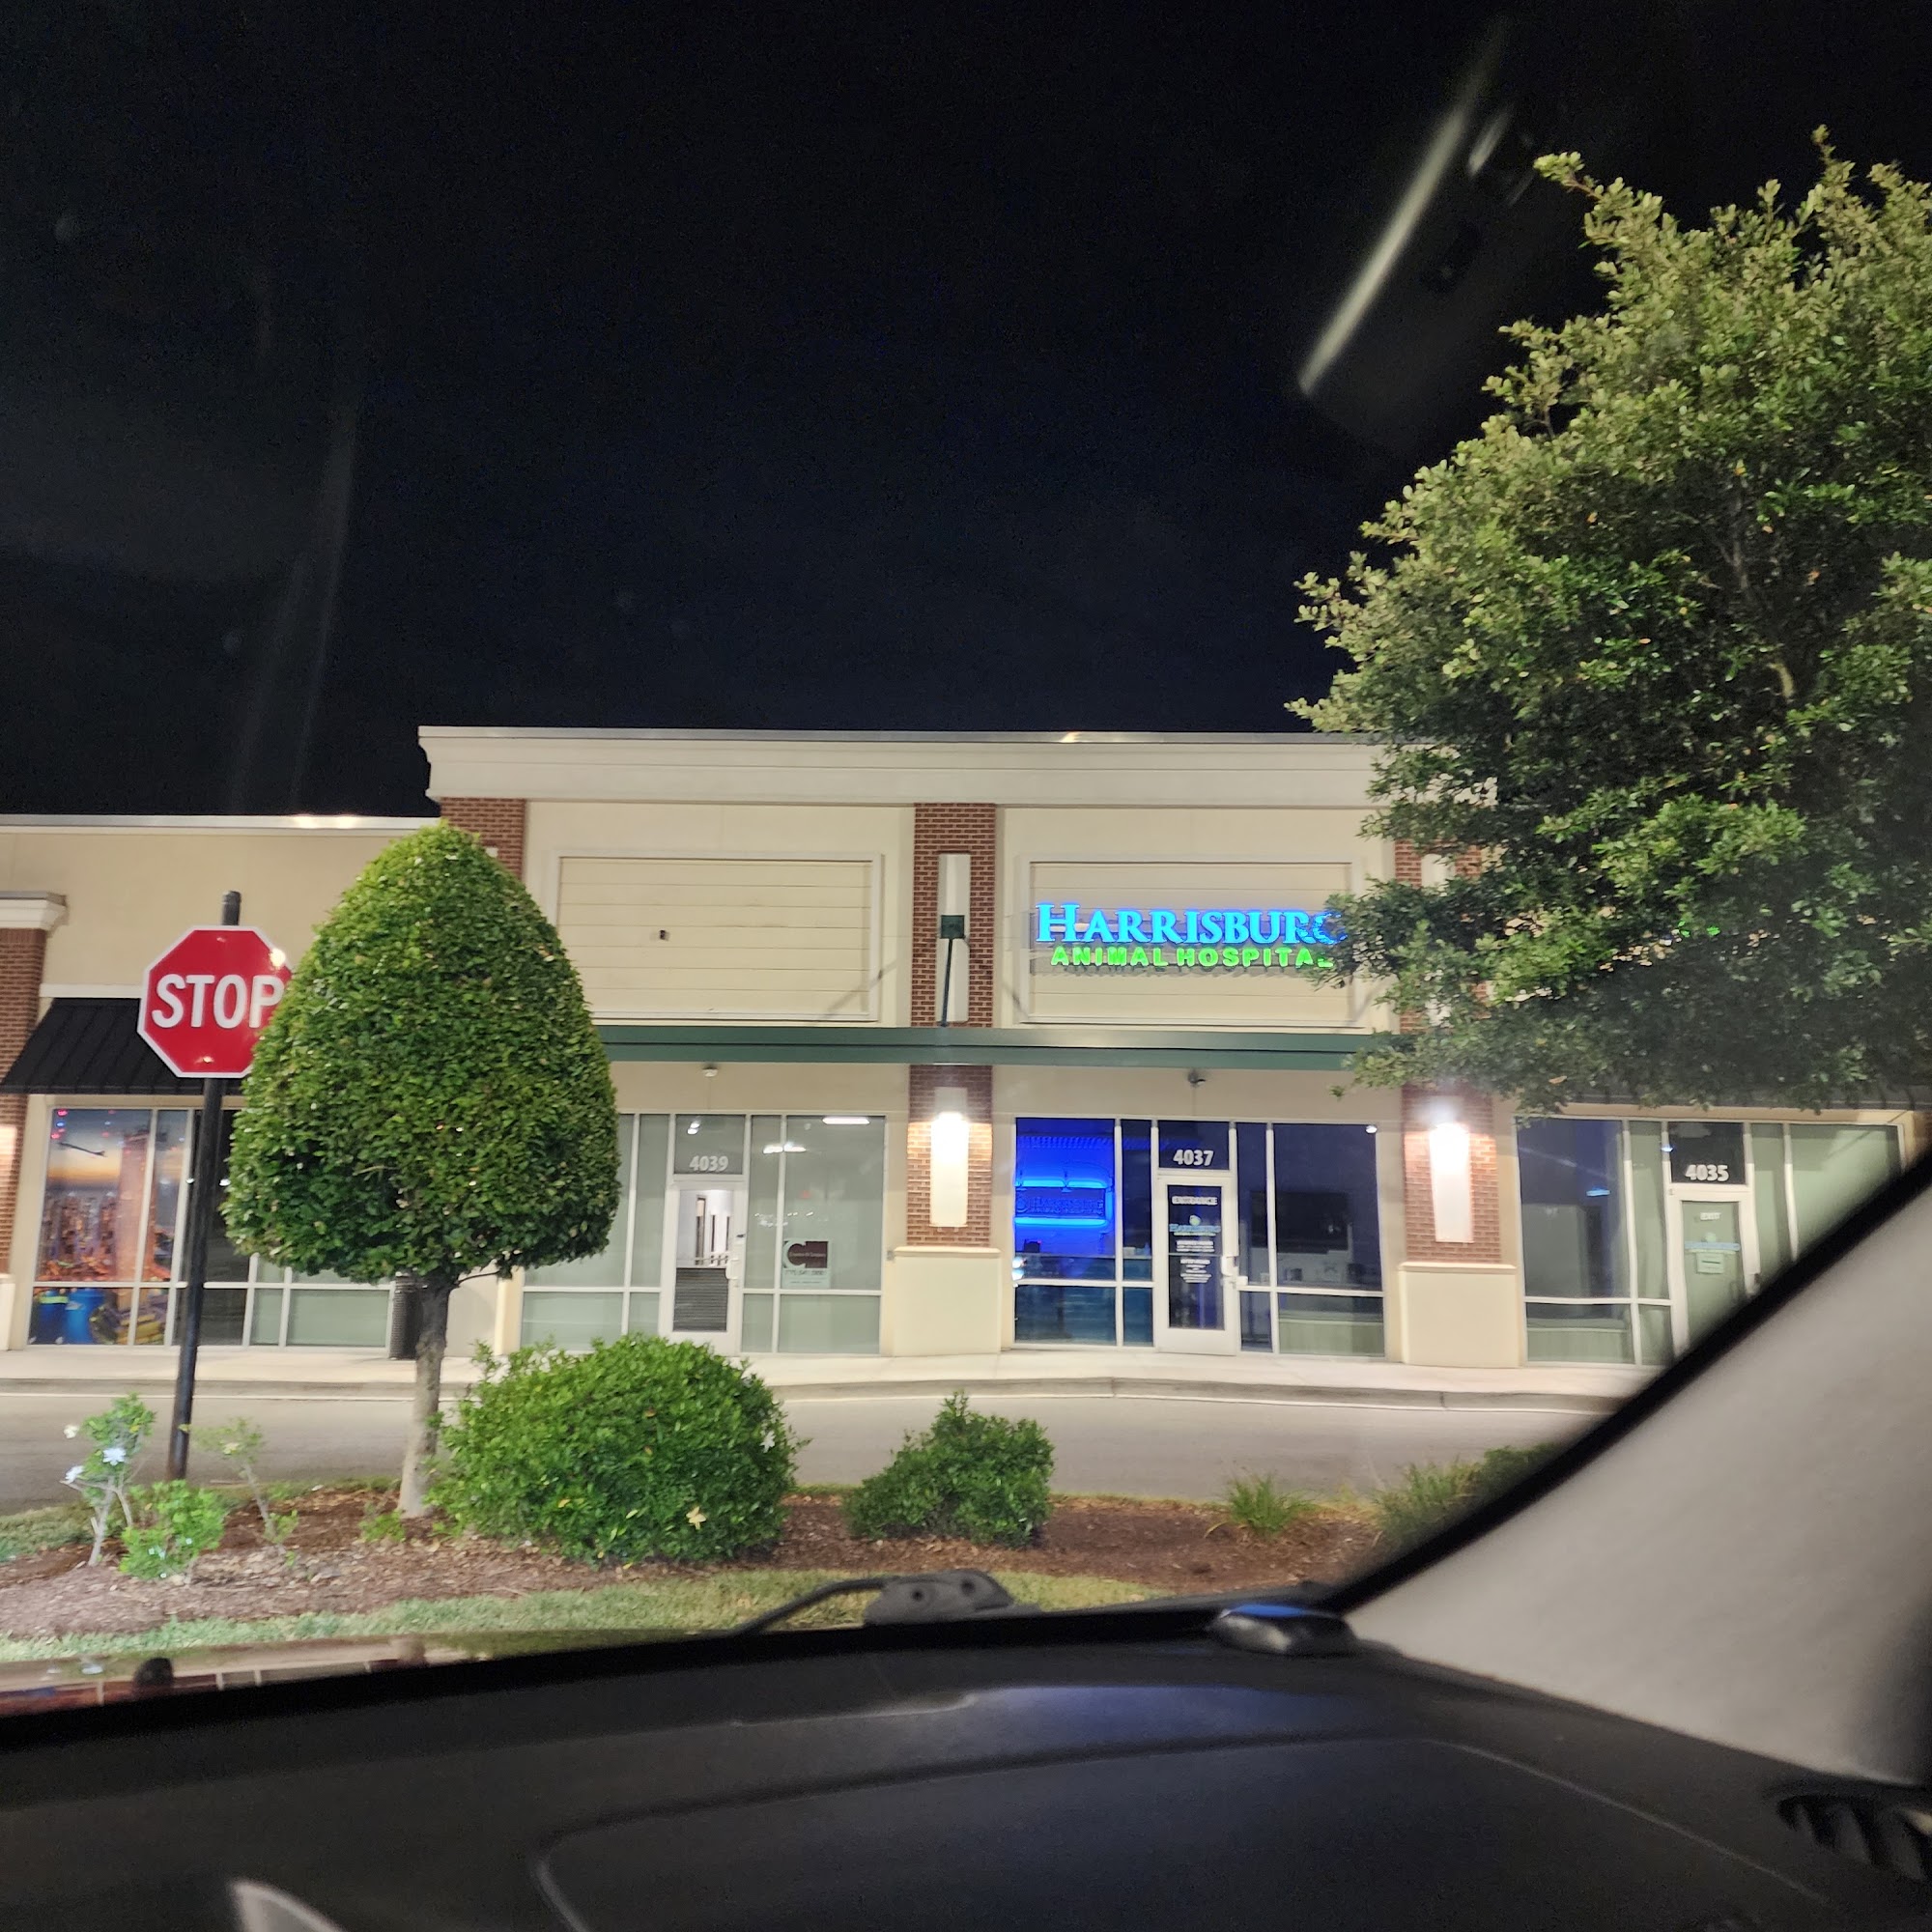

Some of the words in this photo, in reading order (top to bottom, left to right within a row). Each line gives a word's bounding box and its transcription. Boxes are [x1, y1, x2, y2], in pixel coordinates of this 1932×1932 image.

[1050, 946, 1169, 967] ANIMAL
[151, 973, 285, 1029] STOP
[689, 1154, 729, 1173] 4039
[1173, 1149, 1214, 1167] 4037
[1685, 1163, 1730, 1182] 4035
